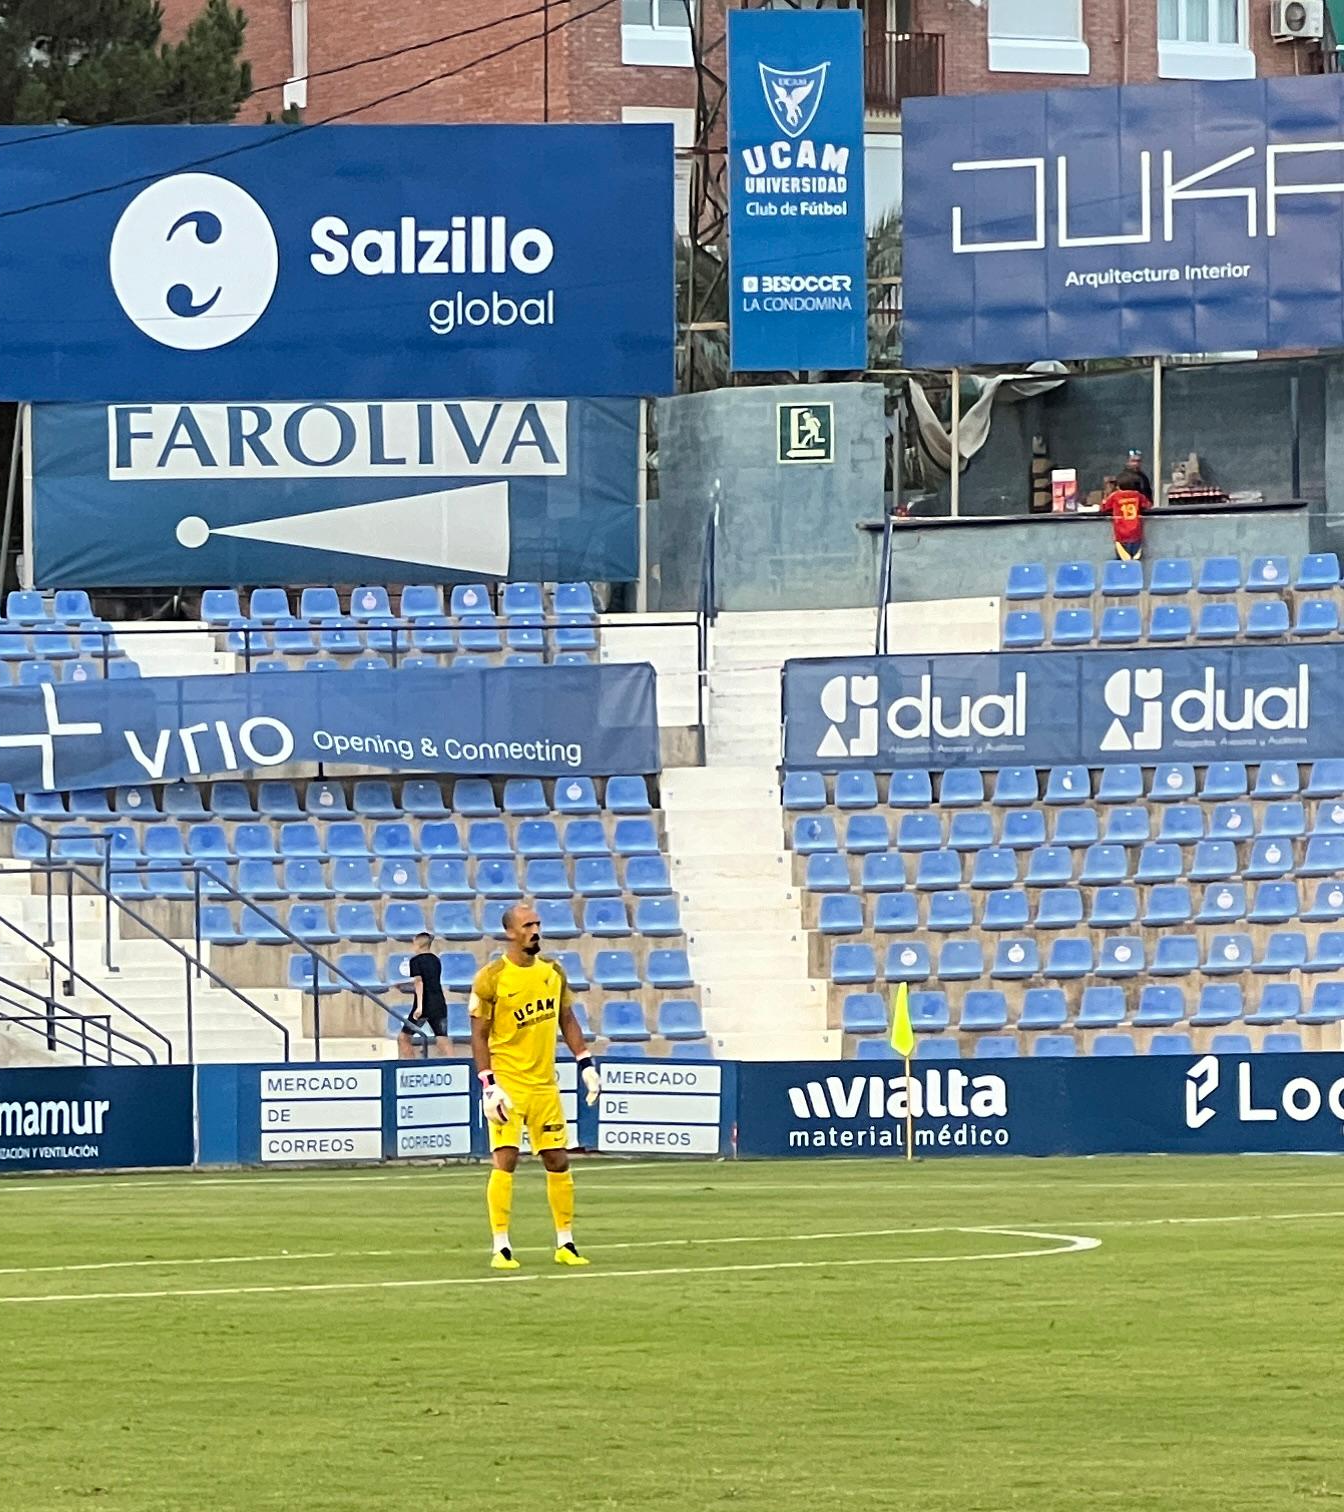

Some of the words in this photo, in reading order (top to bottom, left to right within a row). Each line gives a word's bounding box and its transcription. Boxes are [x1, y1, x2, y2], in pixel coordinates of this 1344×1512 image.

[742, 140, 849, 176] UCAM
[745, 177, 847, 194] UNIVERSIDAD
[746, 201, 777, 216] Club
[780, 201, 797, 216] de
[800, 200, 847, 216] Fútbol
[310, 215, 554, 276] Salzillo
[1065, 266, 1180, 287] Arquitectura
[1185, 263, 1250, 282] Interior
[762, 276, 851, 292] BESOCCER
[429, 290, 554, 334] global
[743, 298, 760, 312] LA
[763, 297, 852, 312] CONDOMINA
[115, 403, 560, 468] FAROLIVA
[887, 672, 1027, 739] dual
[1171, 664, 1309, 732] dual
[313, 731, 414, 760] Opening
[420, 738, 439, 757] &
[444, 738, 582, 767] Connecting
[514, 998, 555, 1021] UCAM
[268, 1077, 358, 1091] MERCADO
[400, 1073, 452, 1089] MERCADO
[606, 1071, 697, 1086] MERCADO
[268, 1109, 291, 1122] DE
[401, 1106, 414, 1119] DE
[606, 1101, 628, 1114] DE
[401, 1134, 452, 1150] CORREOS
[605, 1131, 692, 1146] CORREOS
[789, 1124, 903, 1147] material
[915, 1123, 1009, 1146] médico
[268, 1139, 355, 1153] CORREOS
